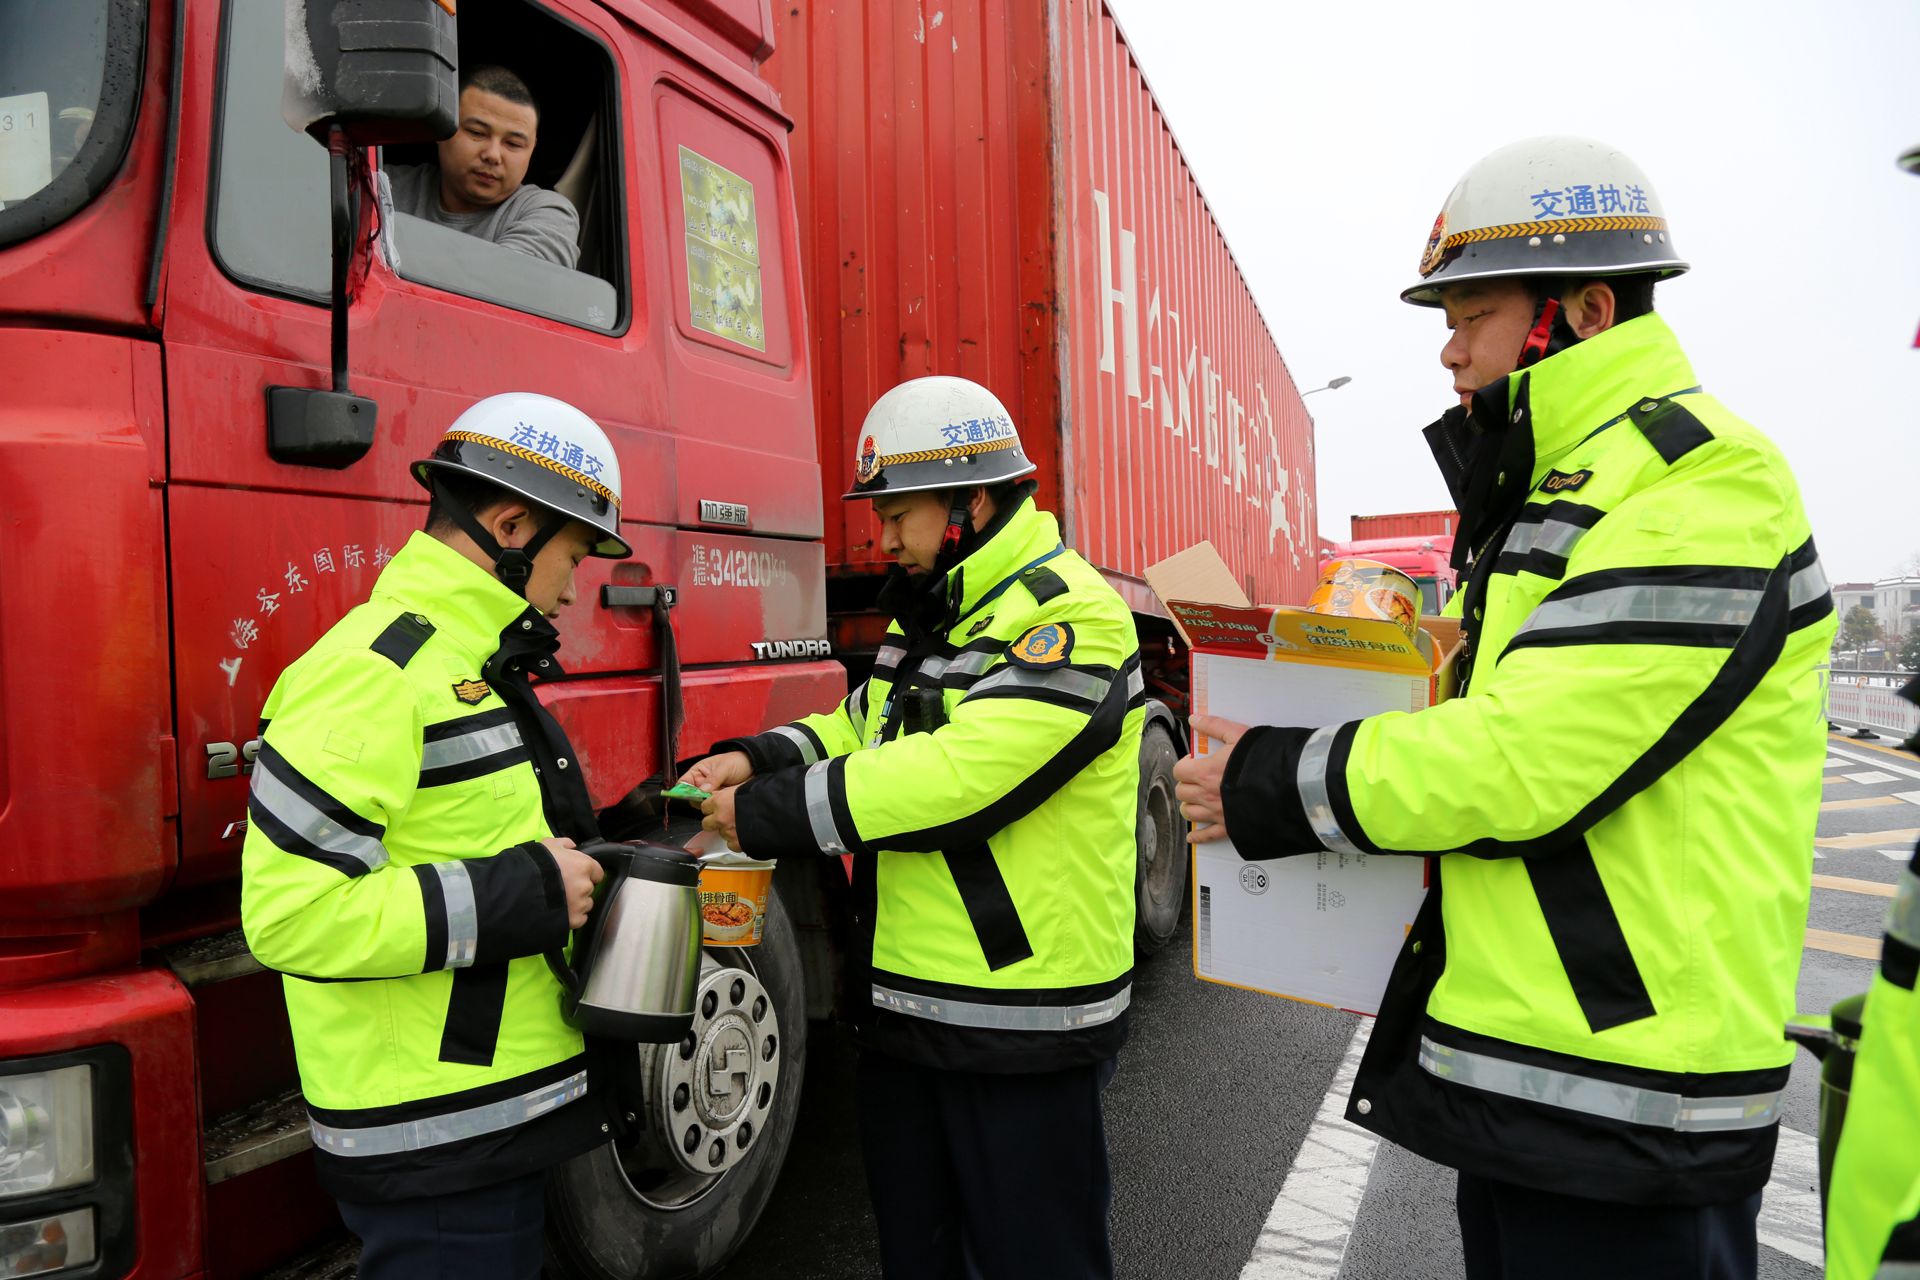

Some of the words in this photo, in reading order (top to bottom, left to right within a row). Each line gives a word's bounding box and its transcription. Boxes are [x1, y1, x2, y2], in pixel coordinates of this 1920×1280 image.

[1530, 183, 1650, 220] 交通执法
[941, 415, 1012, 446] 交通执法
[704, 502, 747, 524] 加强版
[751, 639, 832, 659] TUNDRA
[699, 892, 737, 904] 排骨面
